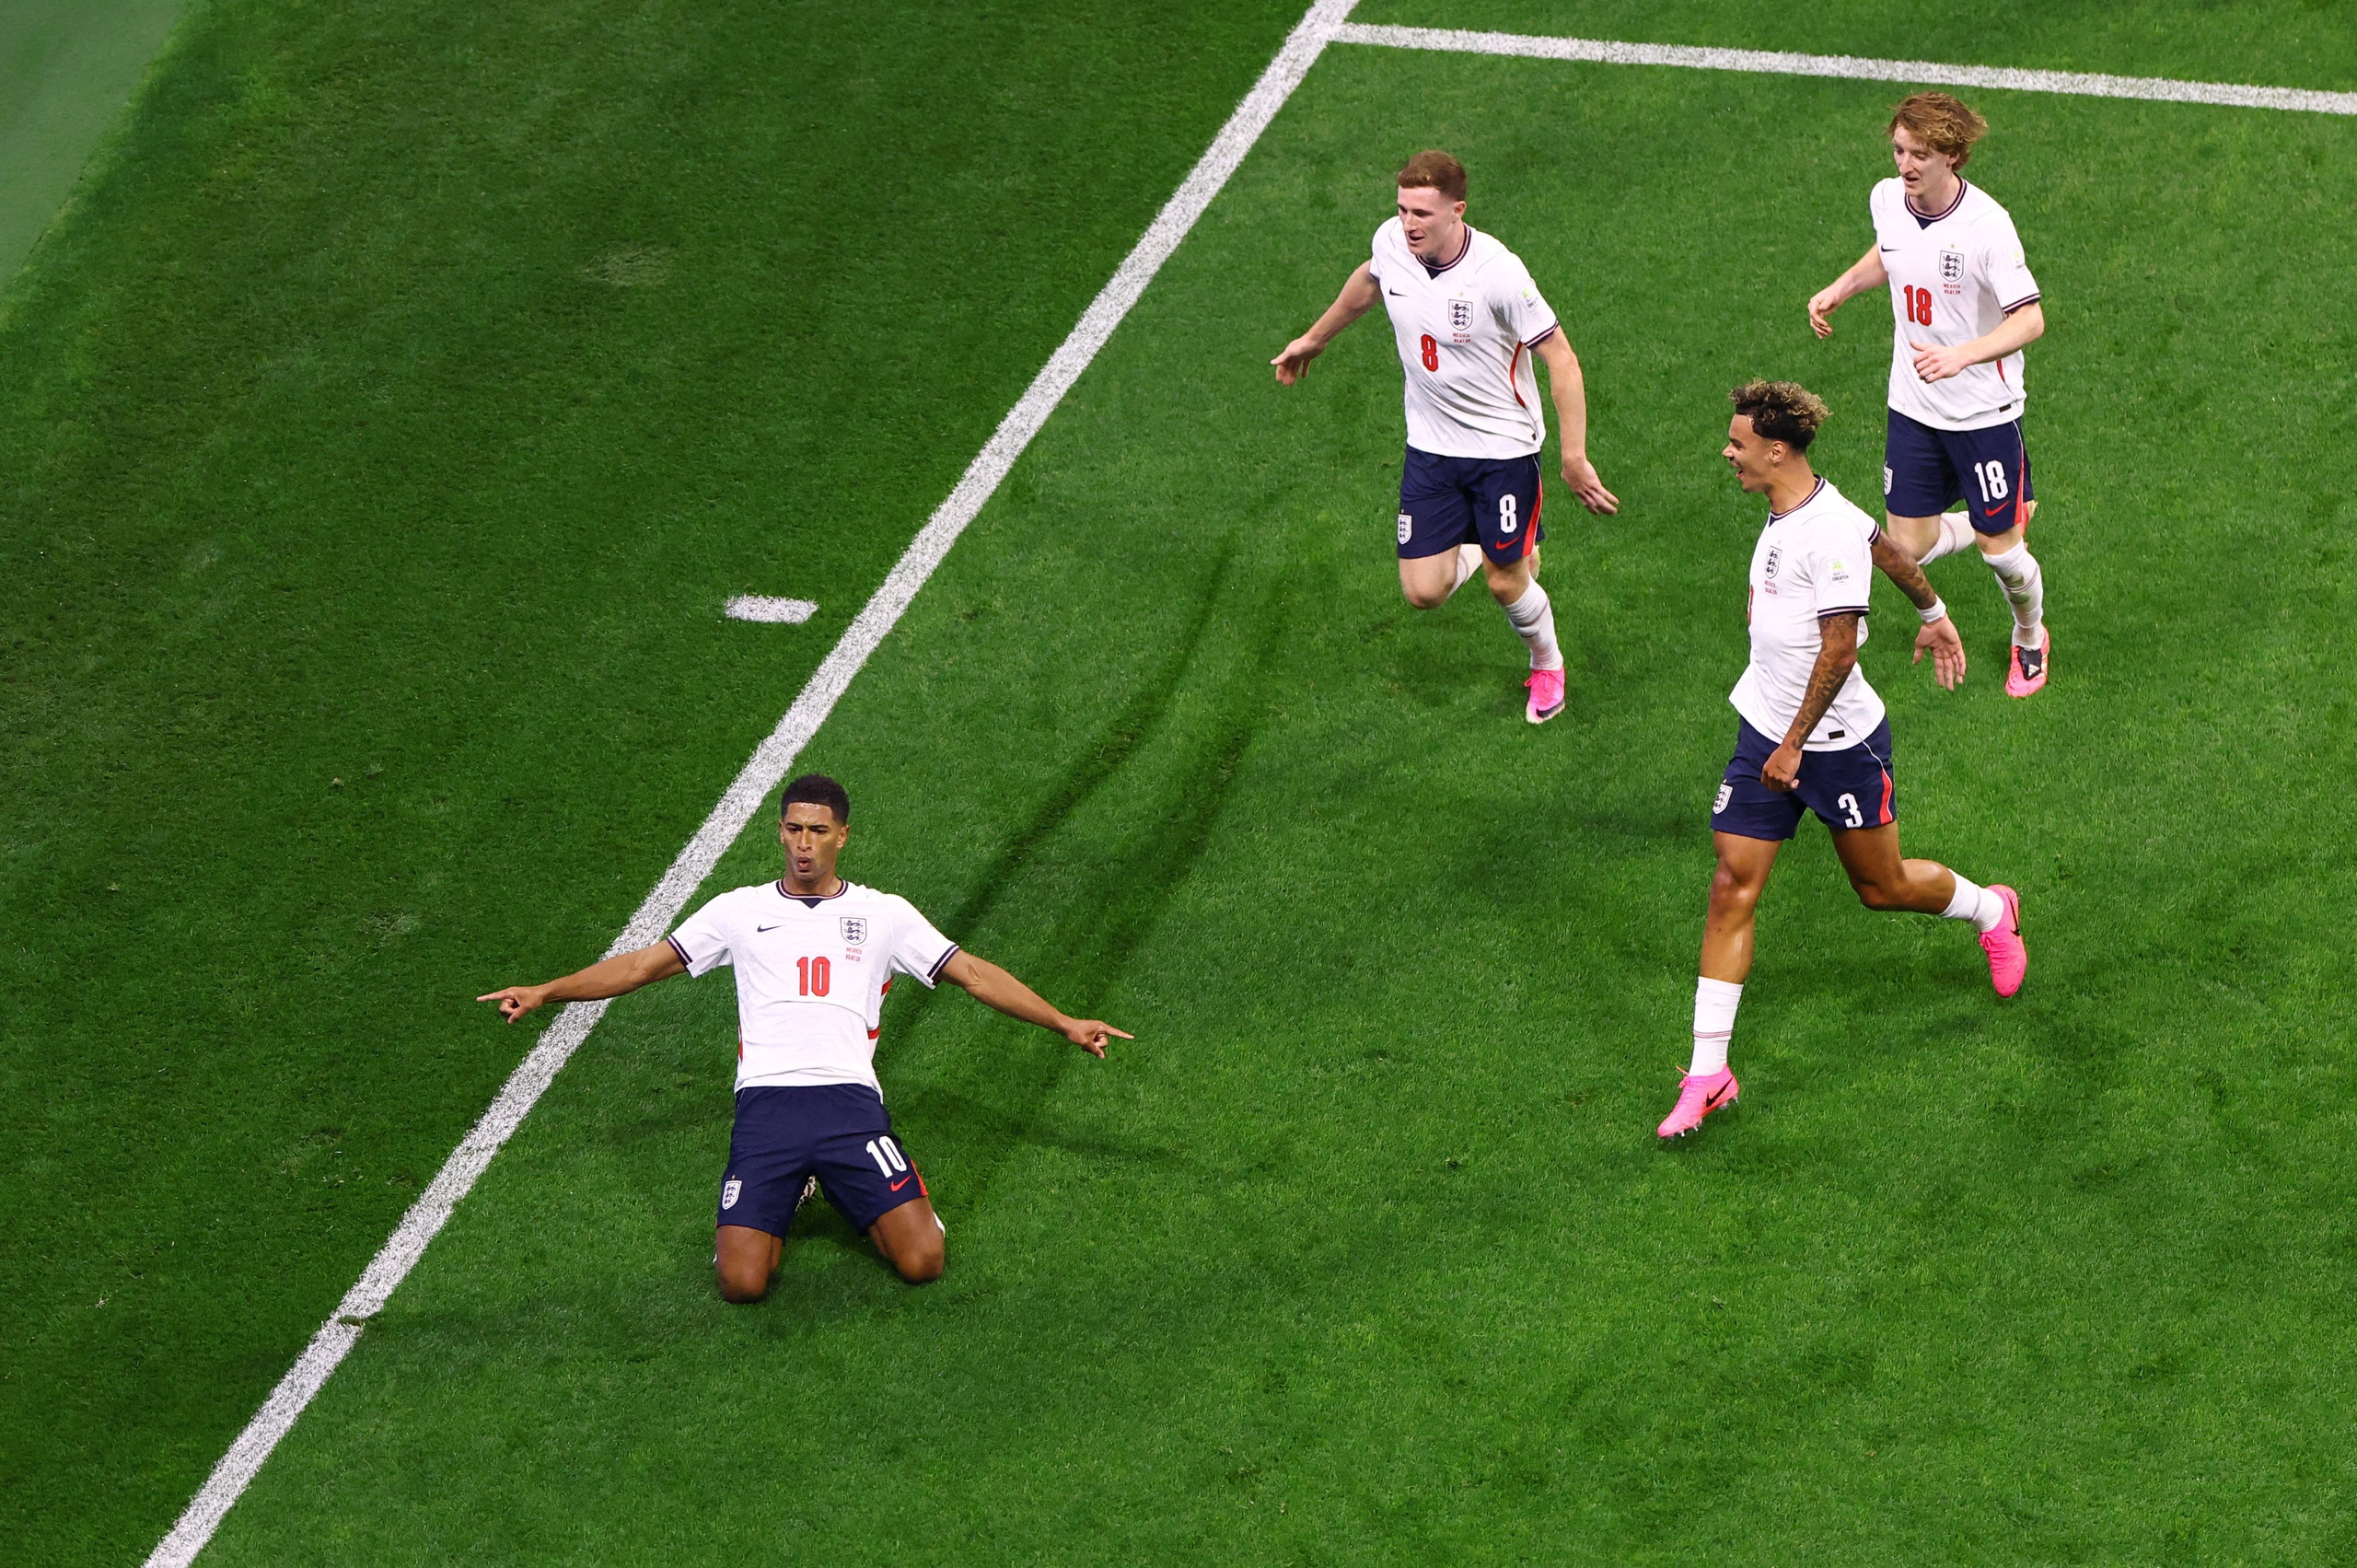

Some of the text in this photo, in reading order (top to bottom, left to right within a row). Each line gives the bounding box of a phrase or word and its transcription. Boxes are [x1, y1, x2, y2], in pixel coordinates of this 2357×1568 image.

[1904, 285, 1932, 326] 18
[1421, 333, 1439, 372] 8
[1974, 459, 2009, 503] 18
[1499, 494, 1518, 534] 8
[1838, 792, 1864, 829] 3
[796, 956, 830, 997] 10
[866, 1135, 907, 1179] 10
